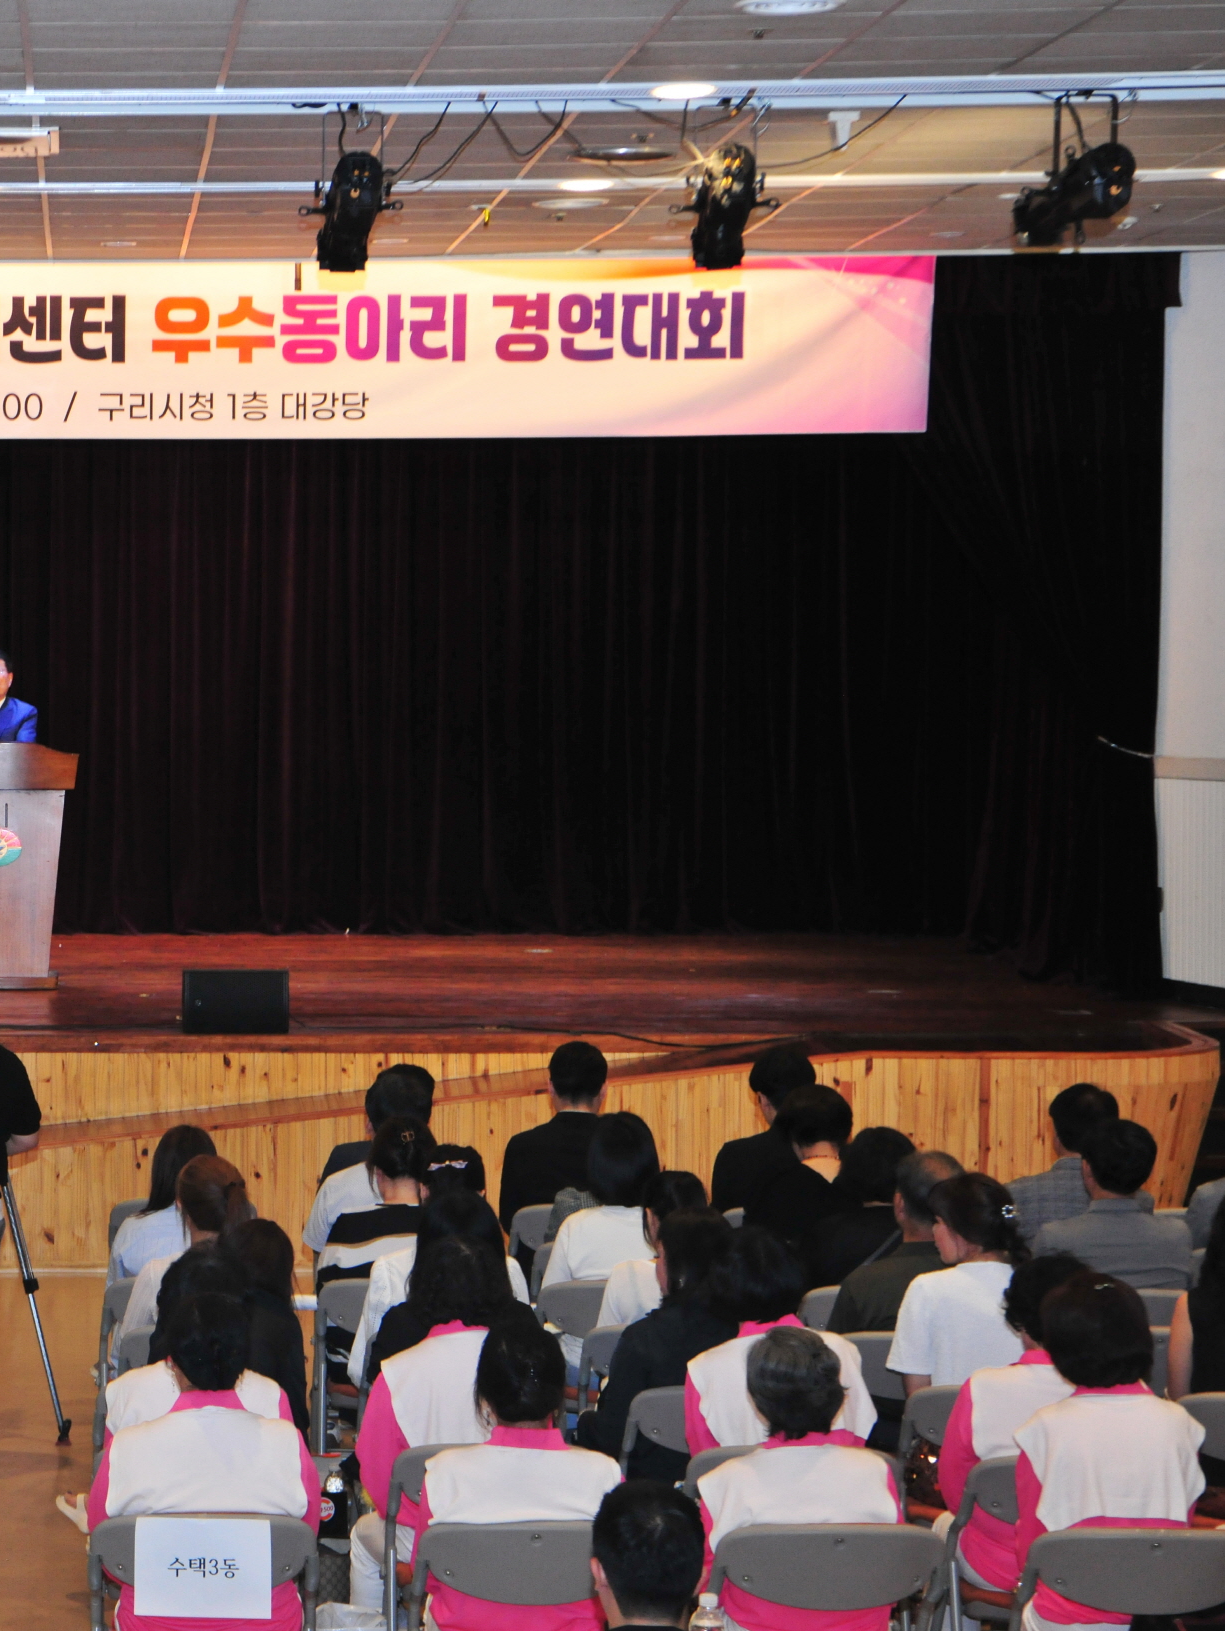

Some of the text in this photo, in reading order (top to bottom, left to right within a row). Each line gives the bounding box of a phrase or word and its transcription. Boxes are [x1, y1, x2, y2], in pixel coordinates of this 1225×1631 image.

[152, 294, 467, 364] 우수동아리
[493, 292, 745, 362] 경연대회
[99, 392, 213, 422] 구리시청
[228, 392, 268, 422] 1층
[281, 392, 370, 422] 대강당
[167, 1556, 240, 1579] 수택3동
